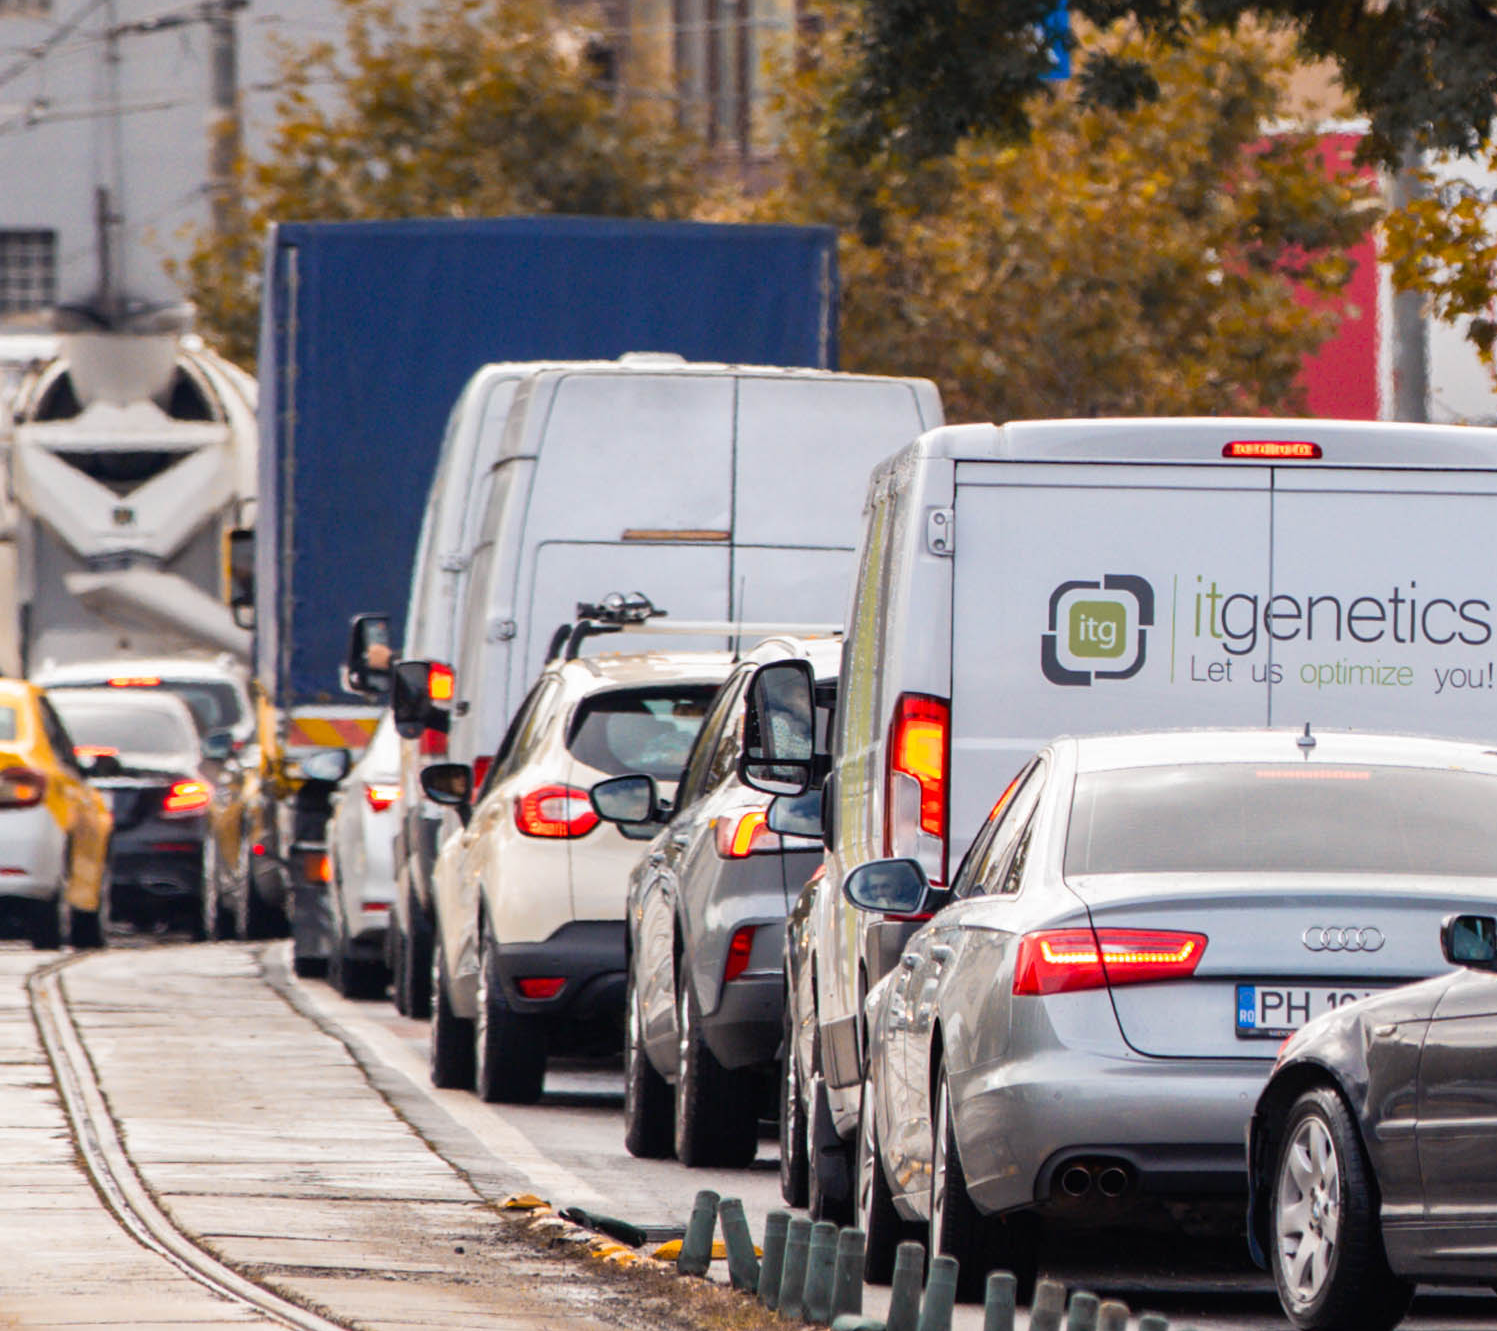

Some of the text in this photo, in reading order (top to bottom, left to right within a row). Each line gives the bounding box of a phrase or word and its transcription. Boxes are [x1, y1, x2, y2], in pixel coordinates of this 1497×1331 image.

[1080, 614, 1117, 650] itg
[1194, 574, 1493, 656] itgenetics
[1190, 655, 1494, 695] Let us optimize you!
[1239, 1009, 1255, 1023] RO
[1260, 990, 1311, 1024] PH
